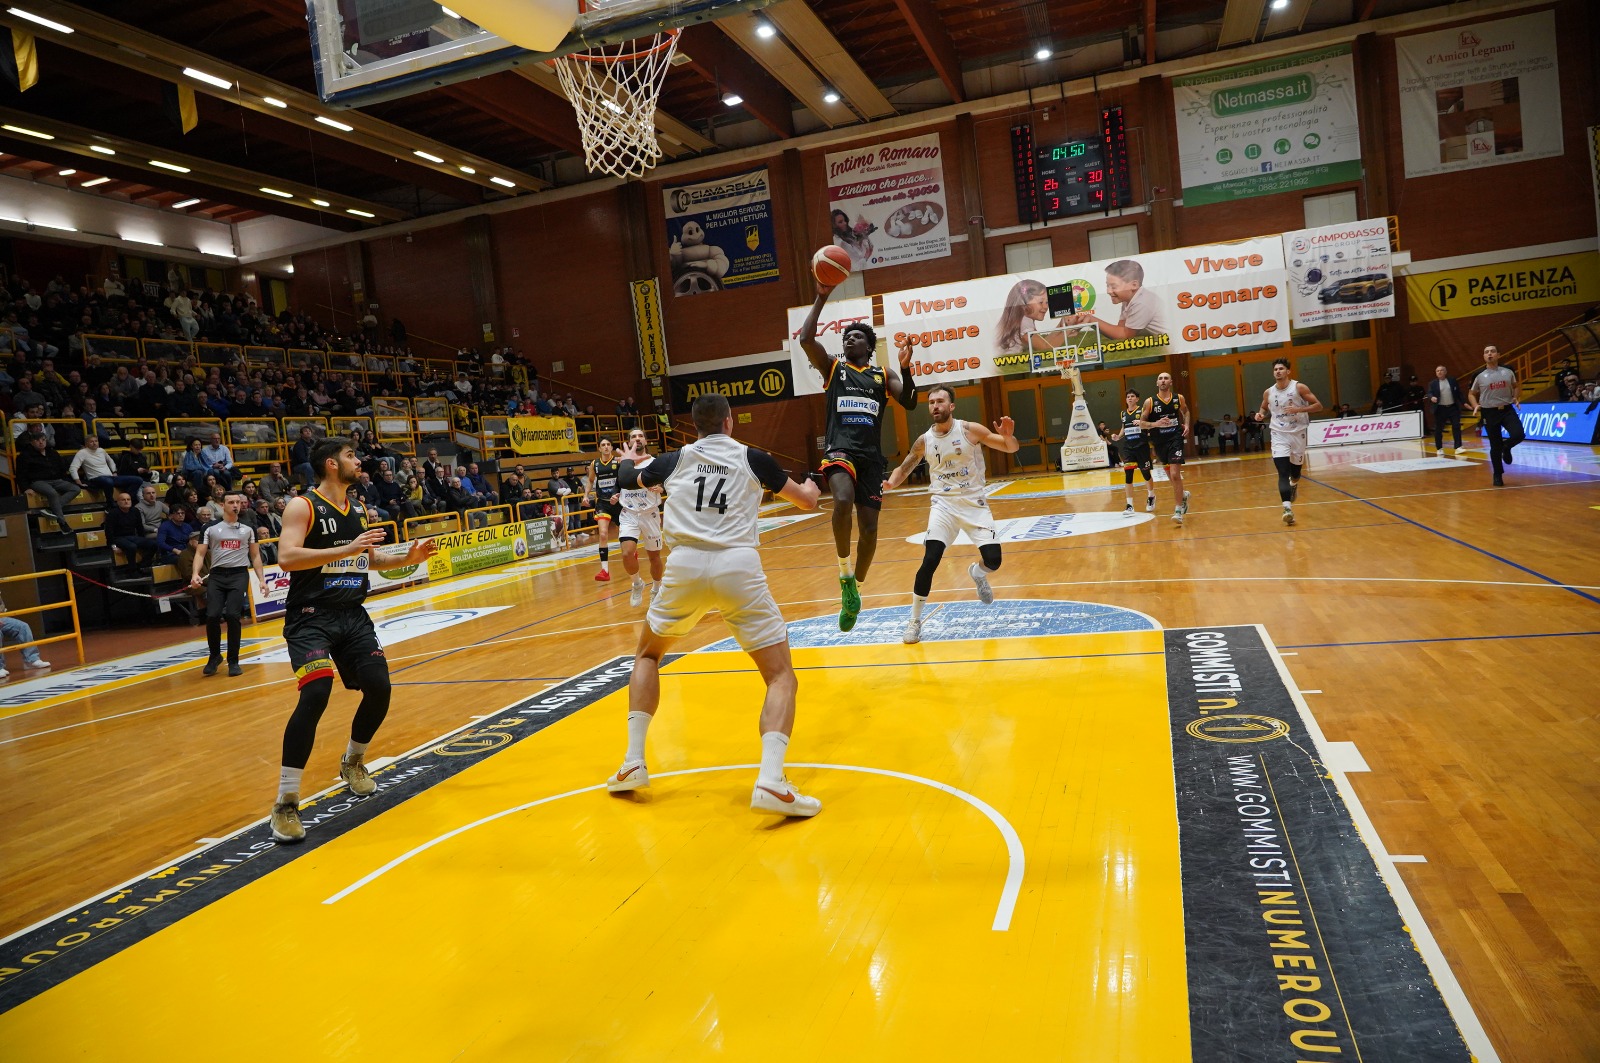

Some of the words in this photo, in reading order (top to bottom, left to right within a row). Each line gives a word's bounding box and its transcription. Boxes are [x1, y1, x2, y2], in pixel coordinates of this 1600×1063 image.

[1472, 41, 1515, 57] Legnami
[1196, 73, 1234, 85] PARTNER
[1237, 69, 1254, 78] PER
[1218, 80, 1307, 109] Netmassa.it
[1204, 121, 1252, 135] Esperienza
[1261, 105, 1328, 127] professionalità
[1214, 135, 1228, 145] per
[1231, 131, 1239, 139] la
[1242, 126, 1271, 137] vostra
[1274, 118, 1319, 132] tecnologia
[830, 153, 875, 178] Intimo
[879, 146, 939, 163] Romano
[1221, 168, 1248, 178] SEGUICI
[1274, 155, 1320, 168] NETMASSA.IT
[838, 184, 876, 197] L'intimo
[879, 179, 896, 189] che
[897, 173, 934, 188] piace...
[1044, 179, 1059, 191] 26
[1087, 170, 1103, 183] 30
[691, 178, 765, 198] CIAVARELLA
[1095, 190, 1103, 201] 4
[713, 210, 737, 220] MIGLIOR
[739, 204, 766, 214] SERVIZIO
[1052, 198, 1059, 209] 3
[740, 212, 768, 223] VETTURA
[1311, 227, 1384, 245] CAMPOBASSO
[1334, 240, 1361, 248] GROUP
[1185, 253, 1263, 274] Vivere
[1468, 266, 1575, 294] PAZIENZA
[1177, 284, 1278, 310] Sognare
[1470, 283, 1577, 307] assicurazioni
[644, 295, 653, 330] FORZA
[900, 296, 967, 316] Vivere
[1362, 301, 1390, 310] NOLEGGIO
[894, 324, 980, 348] Sognare
[1181, 318, 1278, 342] Giocare
[648, 333, 656, 361] NERI
[993, 333, 1169, 366] www.mazzeogiocattoli.it
[840, 370, 847, 380] 3
[687, 379, 755, 402] Allianz
[840, 400, 868, 408] Allianz
[1354, 421, 1401, 432] LOTRAS
[697, 464, 728, 475] RADUNIC
[694, 476, 728, 514] 14
[320, 518, 336, 535] 10
[478, 529, 497, 542] EDIL
[503, 524, 521, 537] CEM
[1186, 632, 1242, 692] GOMMISTI
